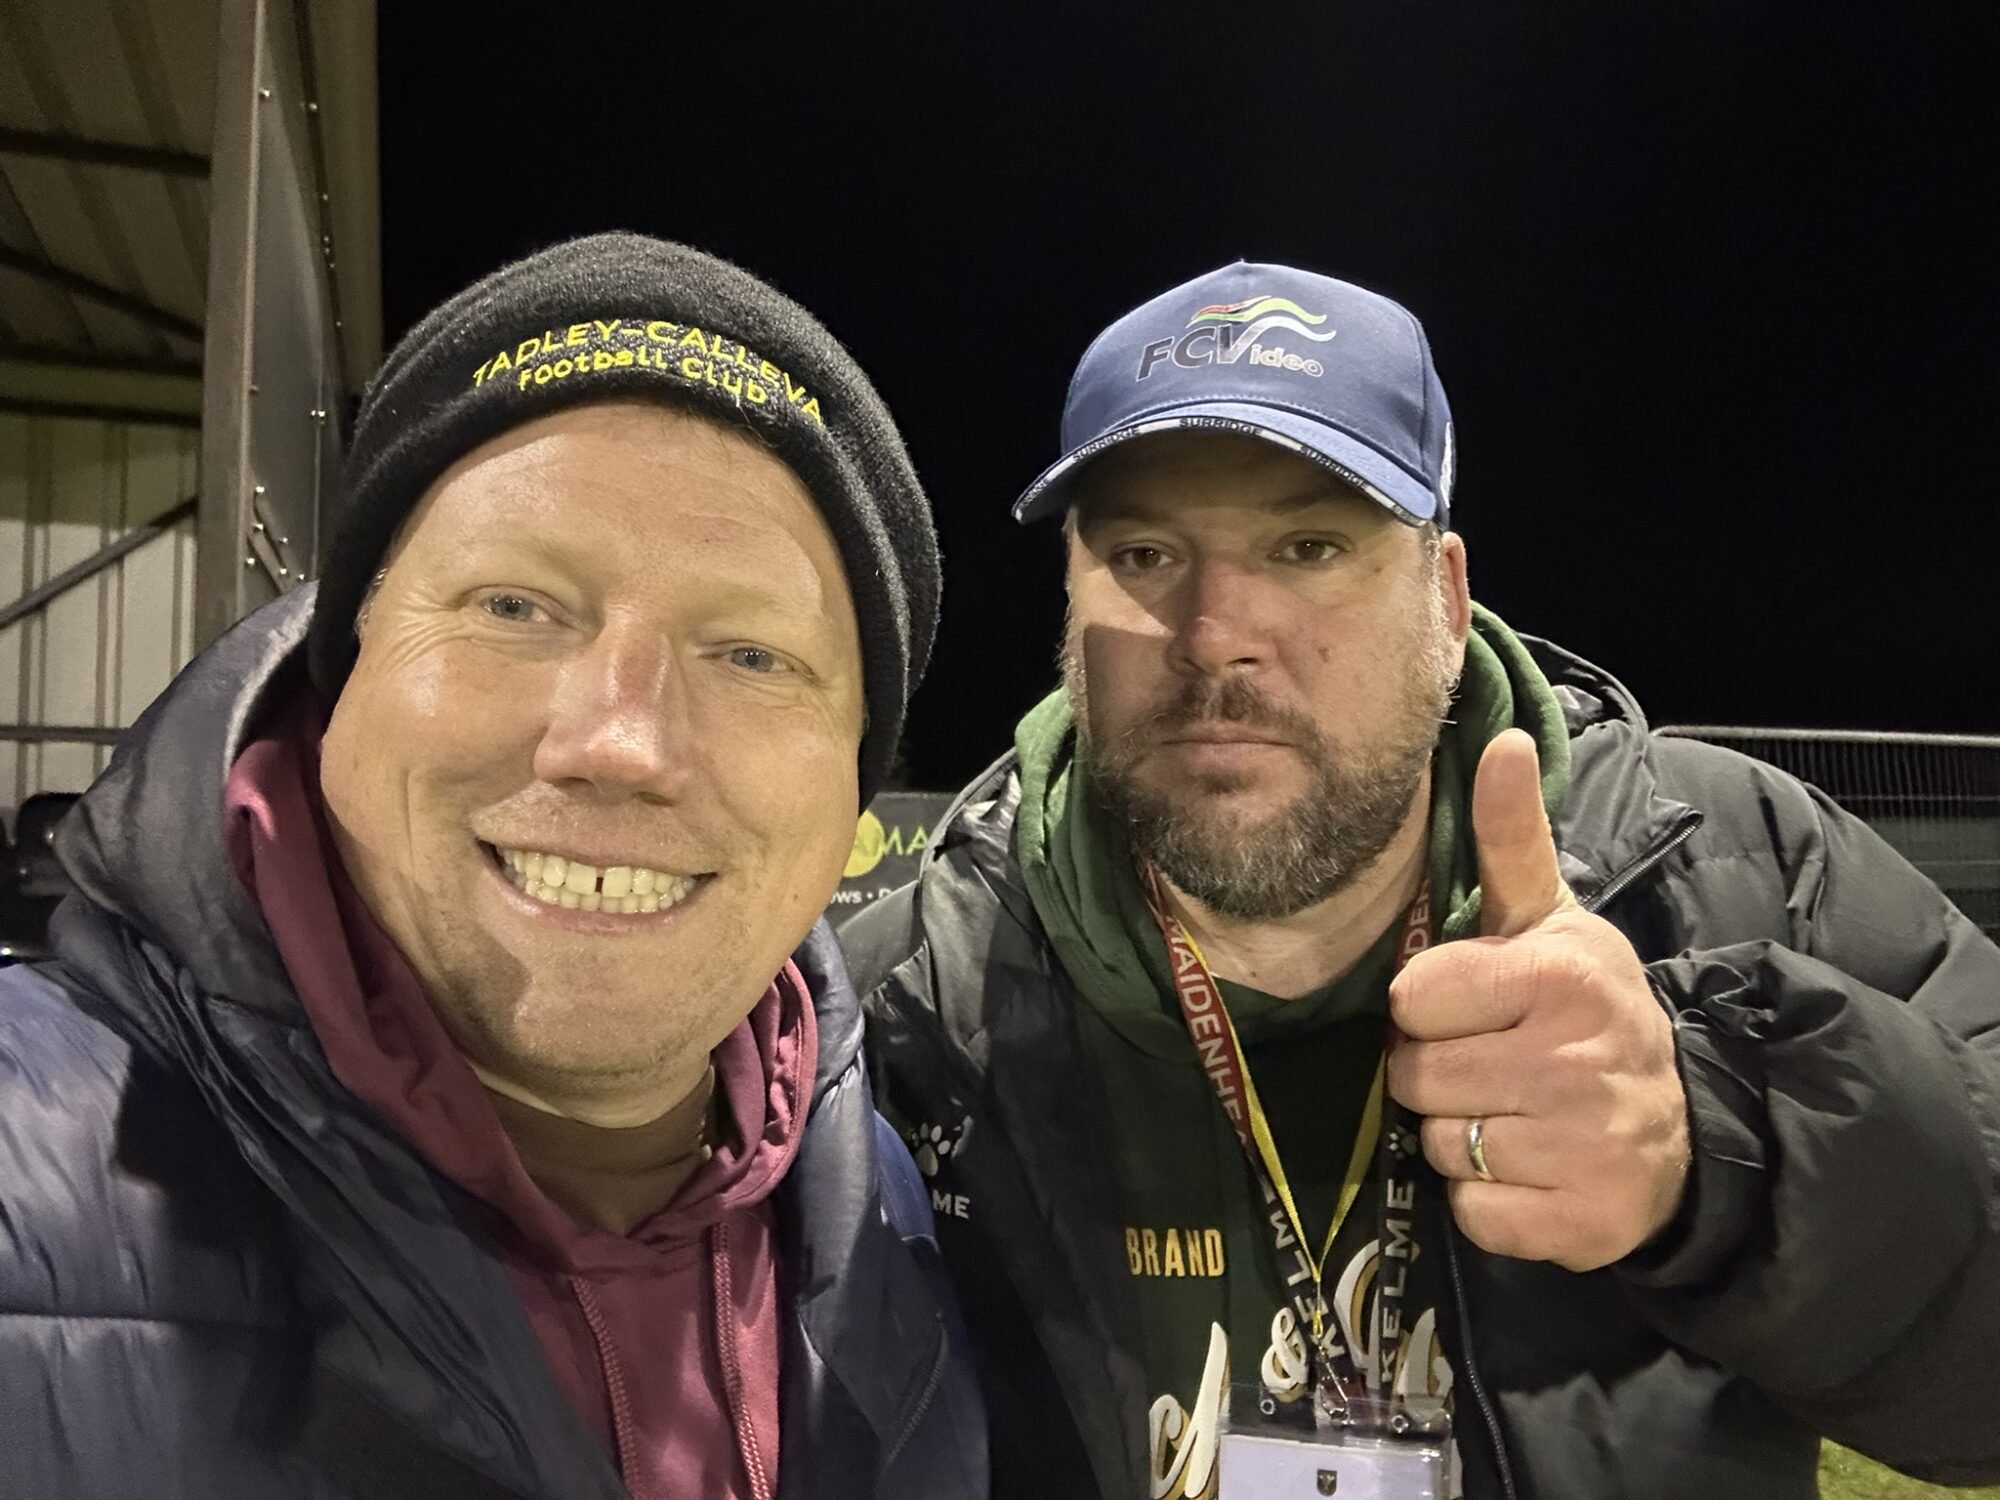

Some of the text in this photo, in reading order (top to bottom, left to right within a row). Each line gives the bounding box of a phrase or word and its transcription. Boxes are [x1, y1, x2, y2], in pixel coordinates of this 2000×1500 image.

[473, 319, 824, 426] TADLEY-CALLEVA
[1180, 417, 1264, 438] SURRIDGE
[1125, 1227, 1226, 1278] BRAND
[1382, 1178, 1414, 1382] KELME
